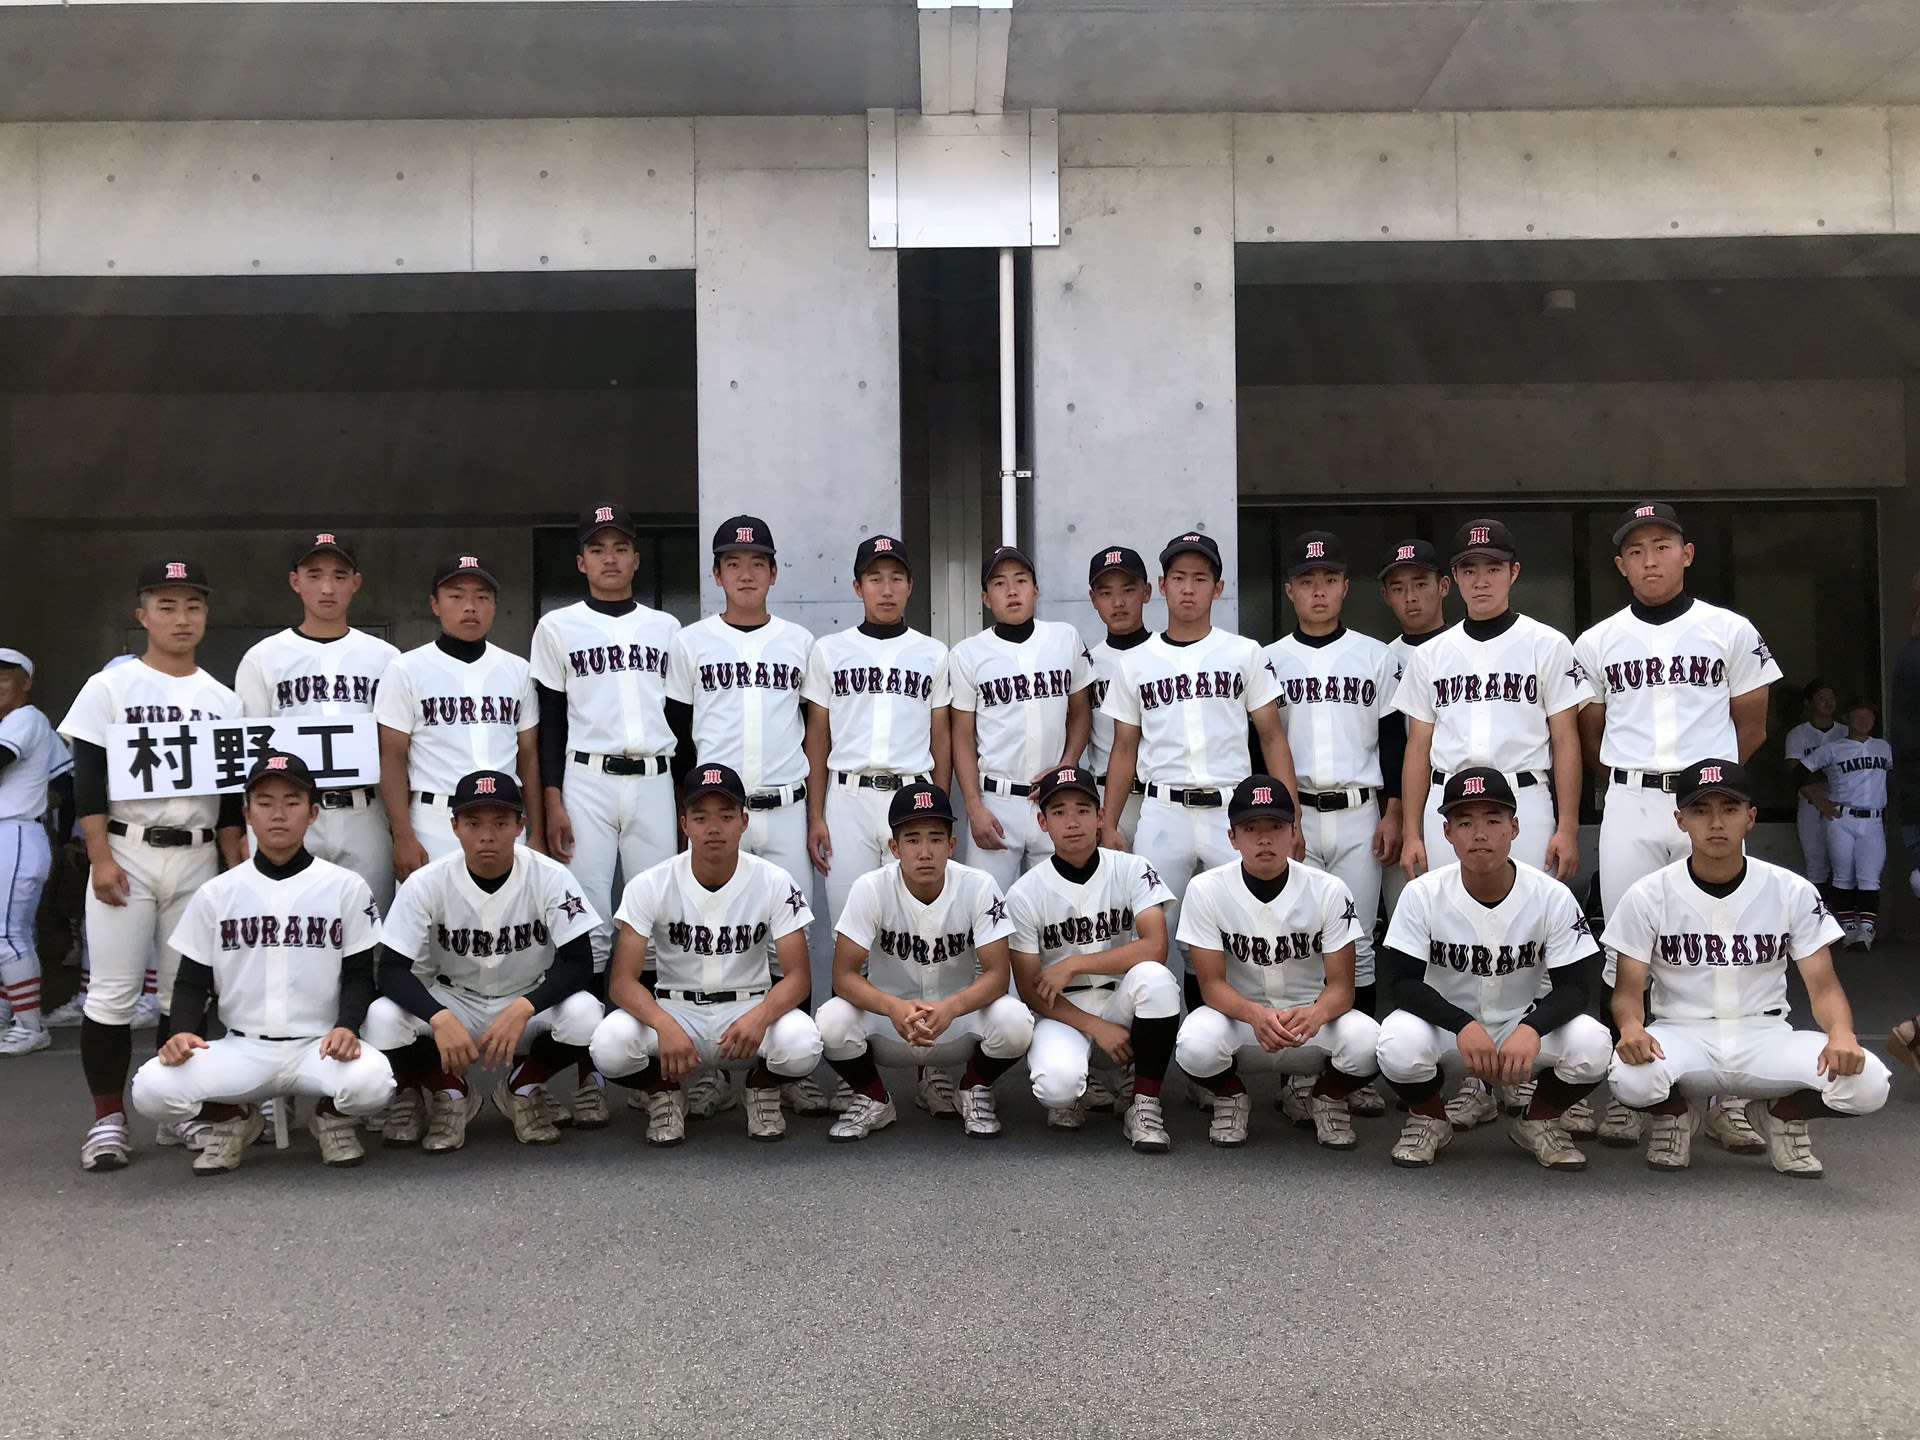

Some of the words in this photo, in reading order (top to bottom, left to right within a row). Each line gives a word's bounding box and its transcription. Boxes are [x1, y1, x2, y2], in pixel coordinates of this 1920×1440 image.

[594, 506, 615, 524] M
[735, 526, 755, 543] M
[1467, 526, 1490, 546] M
[874, 537, 893, 553] M
[1305, 540, 1325, 559] M
[1396, 545, 1416, 562] M
[458, 556, 479, 570] M
[1103, 550, 1122, 566] M
[165, 561, 188, 579] M
[569, 644, 669, 679] MURANO
[699, 662, 801, 692] MURANO
[831, 667, 933, 702] MURANO
[1604, 655, 1729, 694] MURANO
[979, 669, 1072, 708] MURANO
[1139, 670, 1245, 711] MURANO
[1434, 672, 1539, 708] MURANO
[265, 755, 288, 771] M
[702, 769, 722, 786] M
[1056, 768, 1078, 785] M
[1699, 765, 1723, 785] M
[475, 776, 497, 796] M
[1251, 786, 1273, 806] M
[1462, 776, 1486, 797] M
[913, 791, 934, 810] M
[220, 915, 344, 953] MURANO
